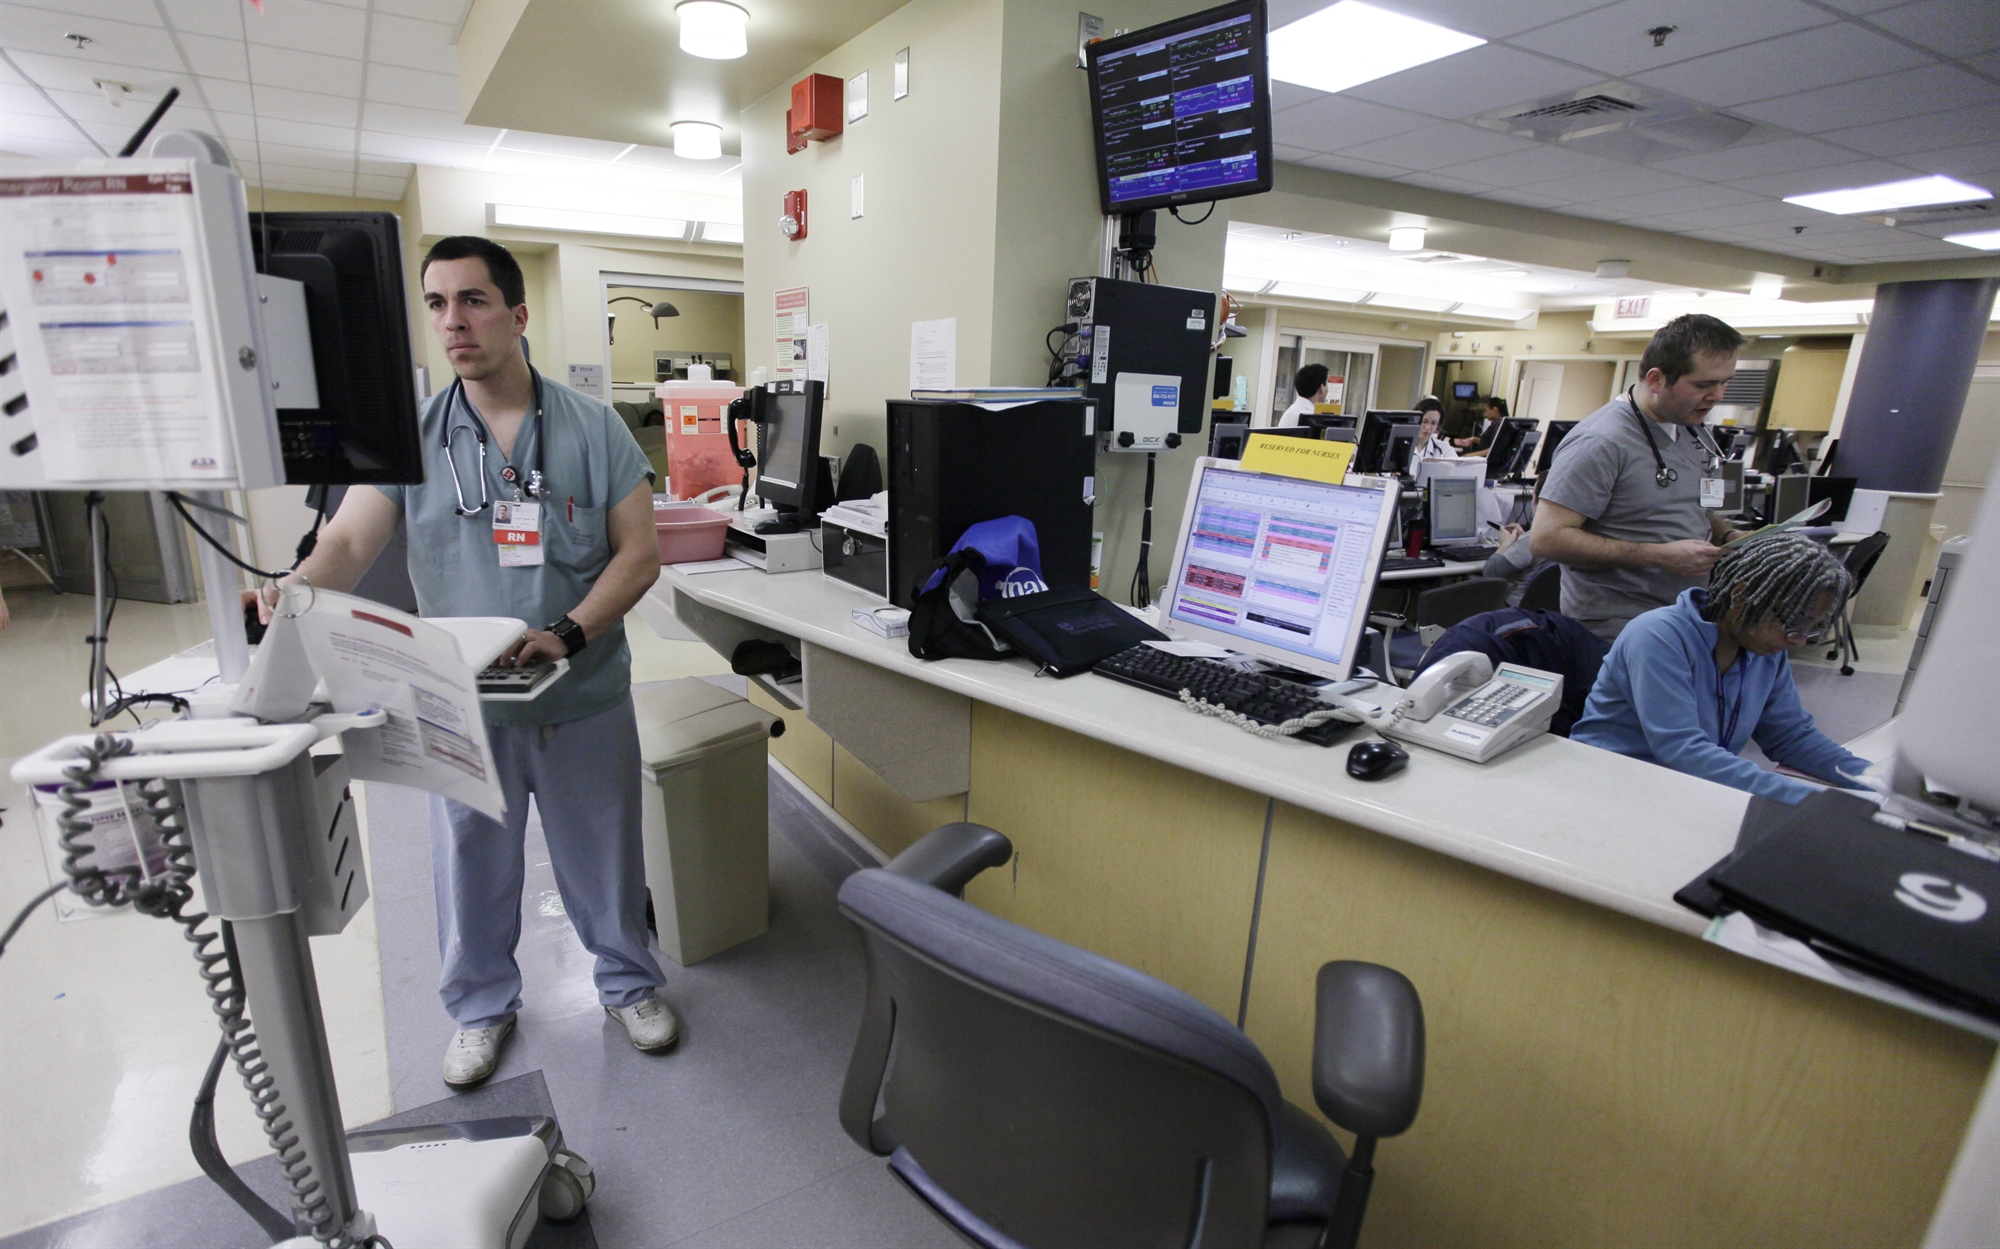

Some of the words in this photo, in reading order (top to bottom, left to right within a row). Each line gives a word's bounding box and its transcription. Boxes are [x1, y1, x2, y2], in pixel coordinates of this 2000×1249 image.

[1617, 298, 1648, 315] EXIT
[1259, 443, 1295, 453] RESERVED
[1295, 447, 1311, 455] FOR
[1311, 449, 1341, 459] NURSES
[507, 532, 526, 542] RN
